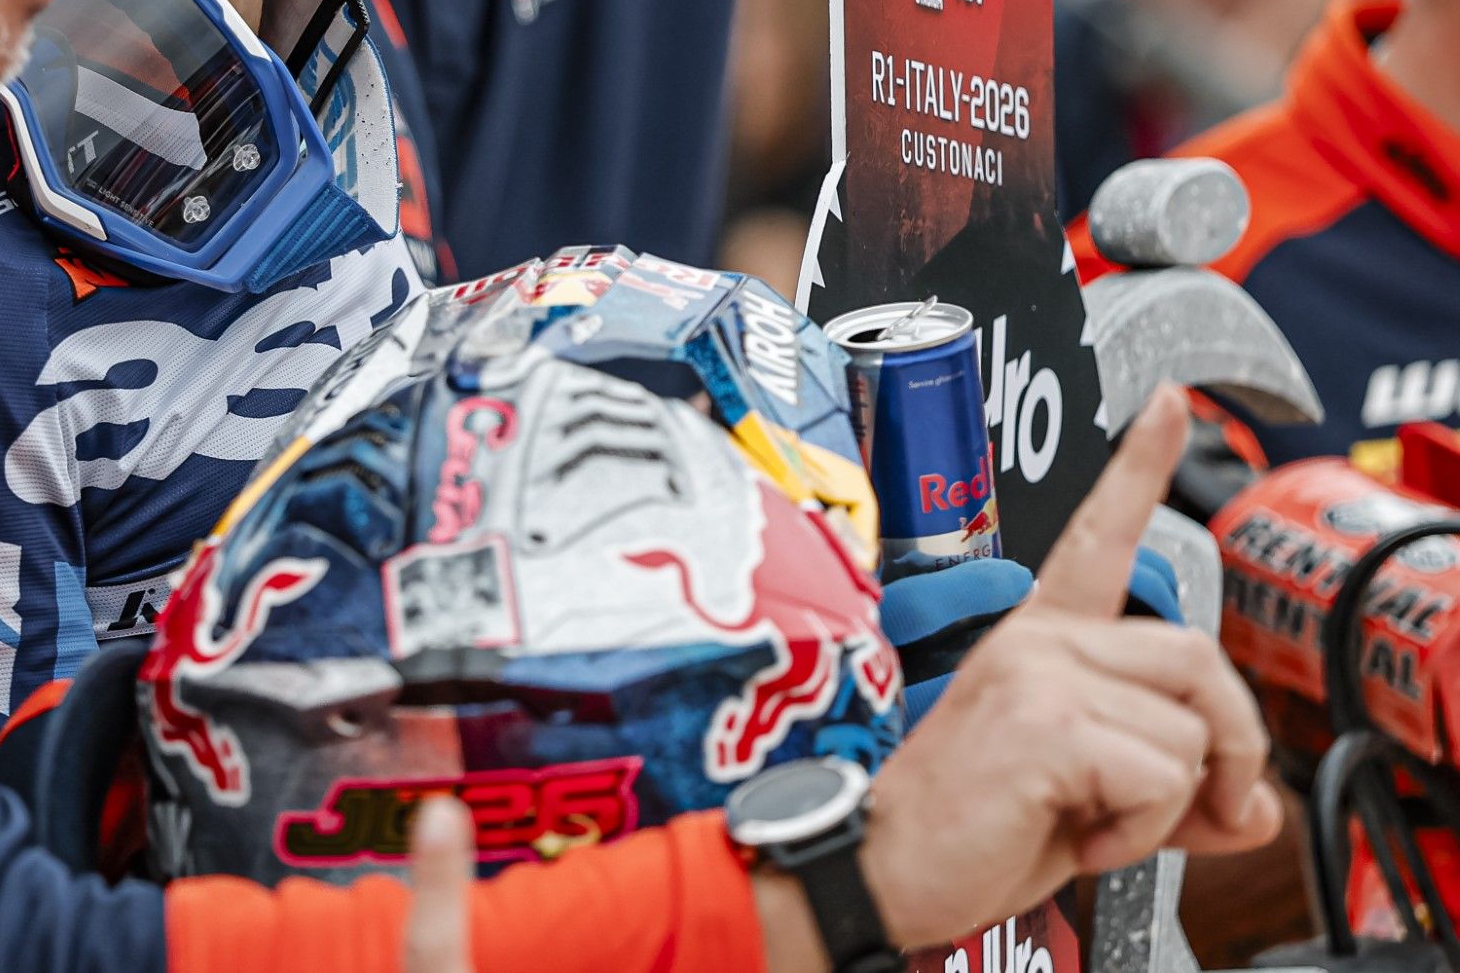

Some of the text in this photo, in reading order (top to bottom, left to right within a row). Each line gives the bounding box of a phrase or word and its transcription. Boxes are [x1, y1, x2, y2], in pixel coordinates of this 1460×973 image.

[870, 49, 1031, 140] R1-ITALY-2026
[98, 186, 120, 204] LIGHT
[900, 128, 1004, 187] CUSTONACI
[742, 289, 799, 406] AIROH
[918, 455, 989, 514] Red
[1227, 516, 1449, 641] RENTAL
